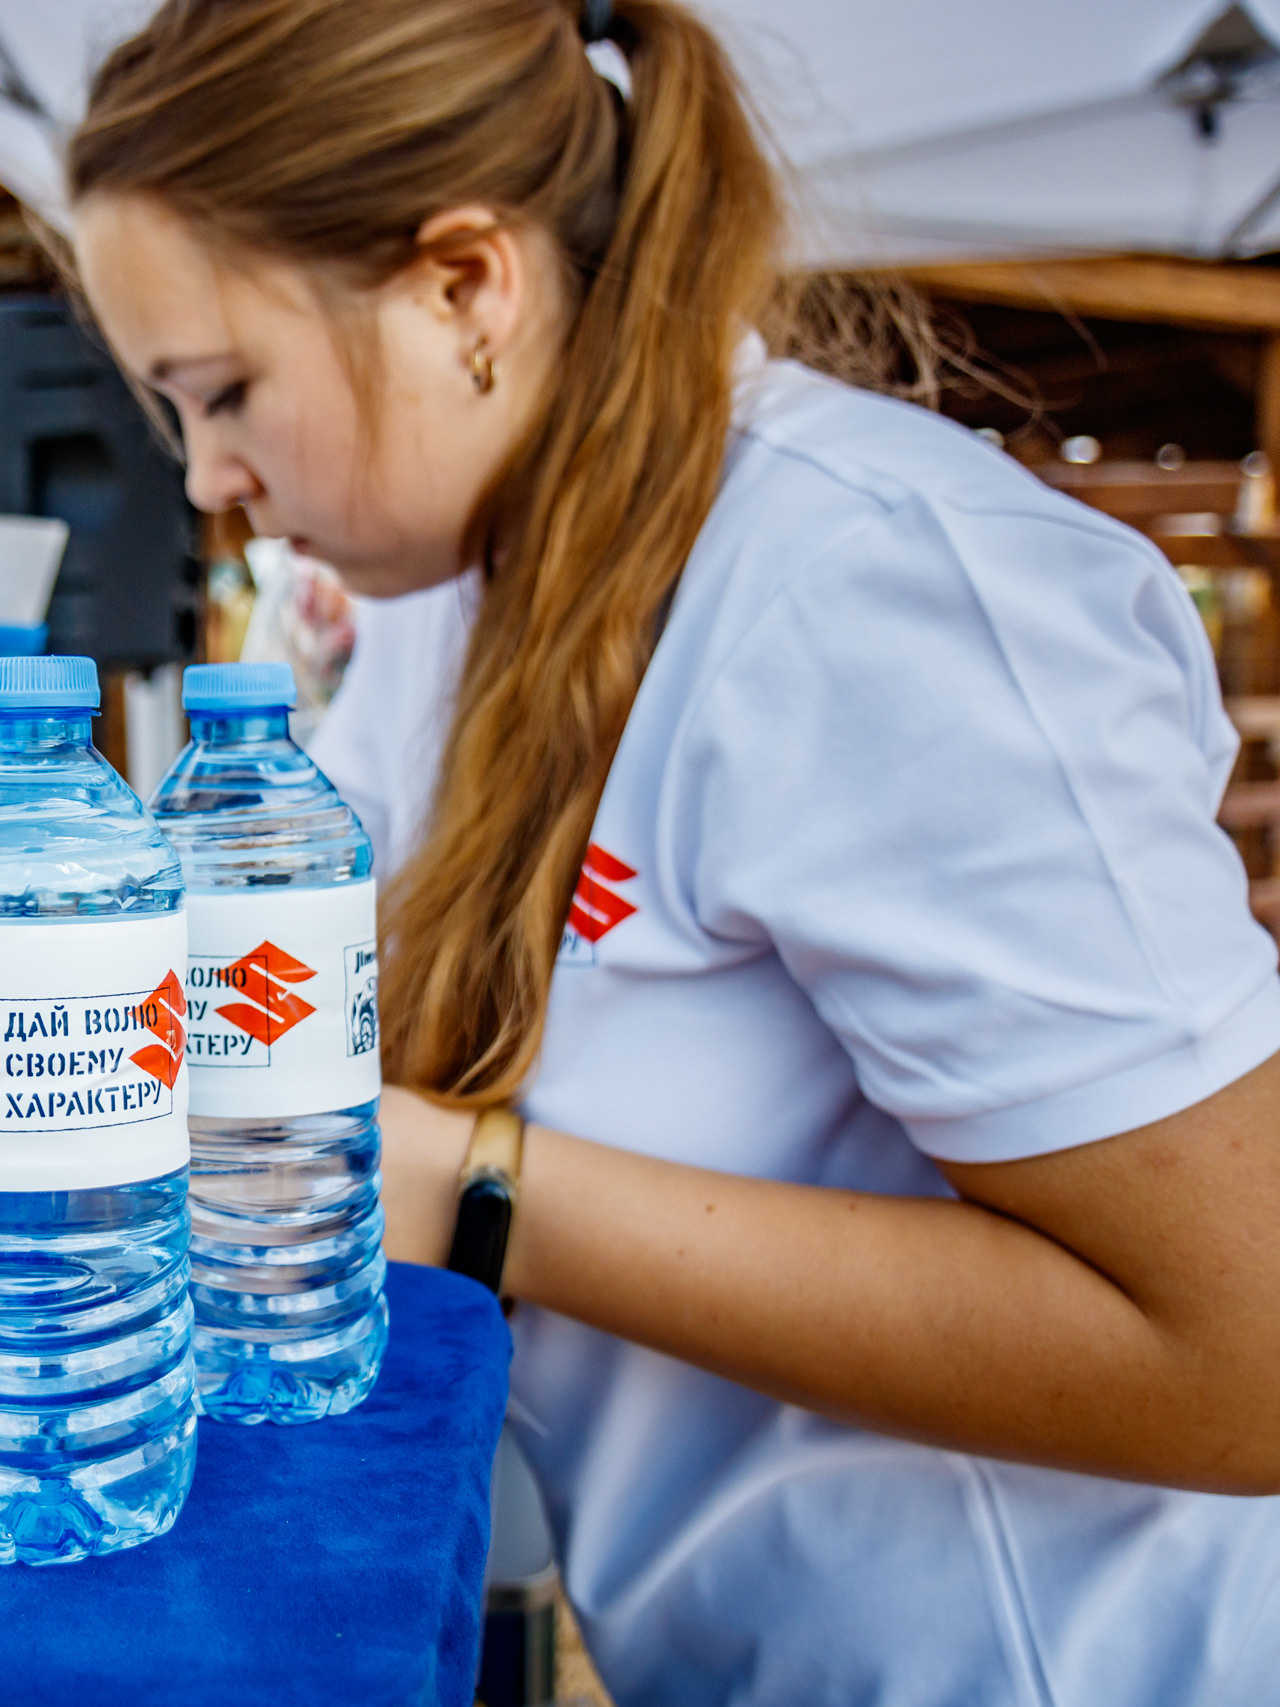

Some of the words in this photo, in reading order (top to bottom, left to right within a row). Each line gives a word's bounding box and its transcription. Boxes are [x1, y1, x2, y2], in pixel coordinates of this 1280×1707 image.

[186, 967, 247, 988] ОЛЮ
[4, 1004, 69, 1042] ДАЙ
[85, 1003, 159, 1035] ВОЛЮ
[5, 1047, 124, 1078] СВОЕМУ
[5, 1079, 162, 1119] ХАРАКТЕРУ
